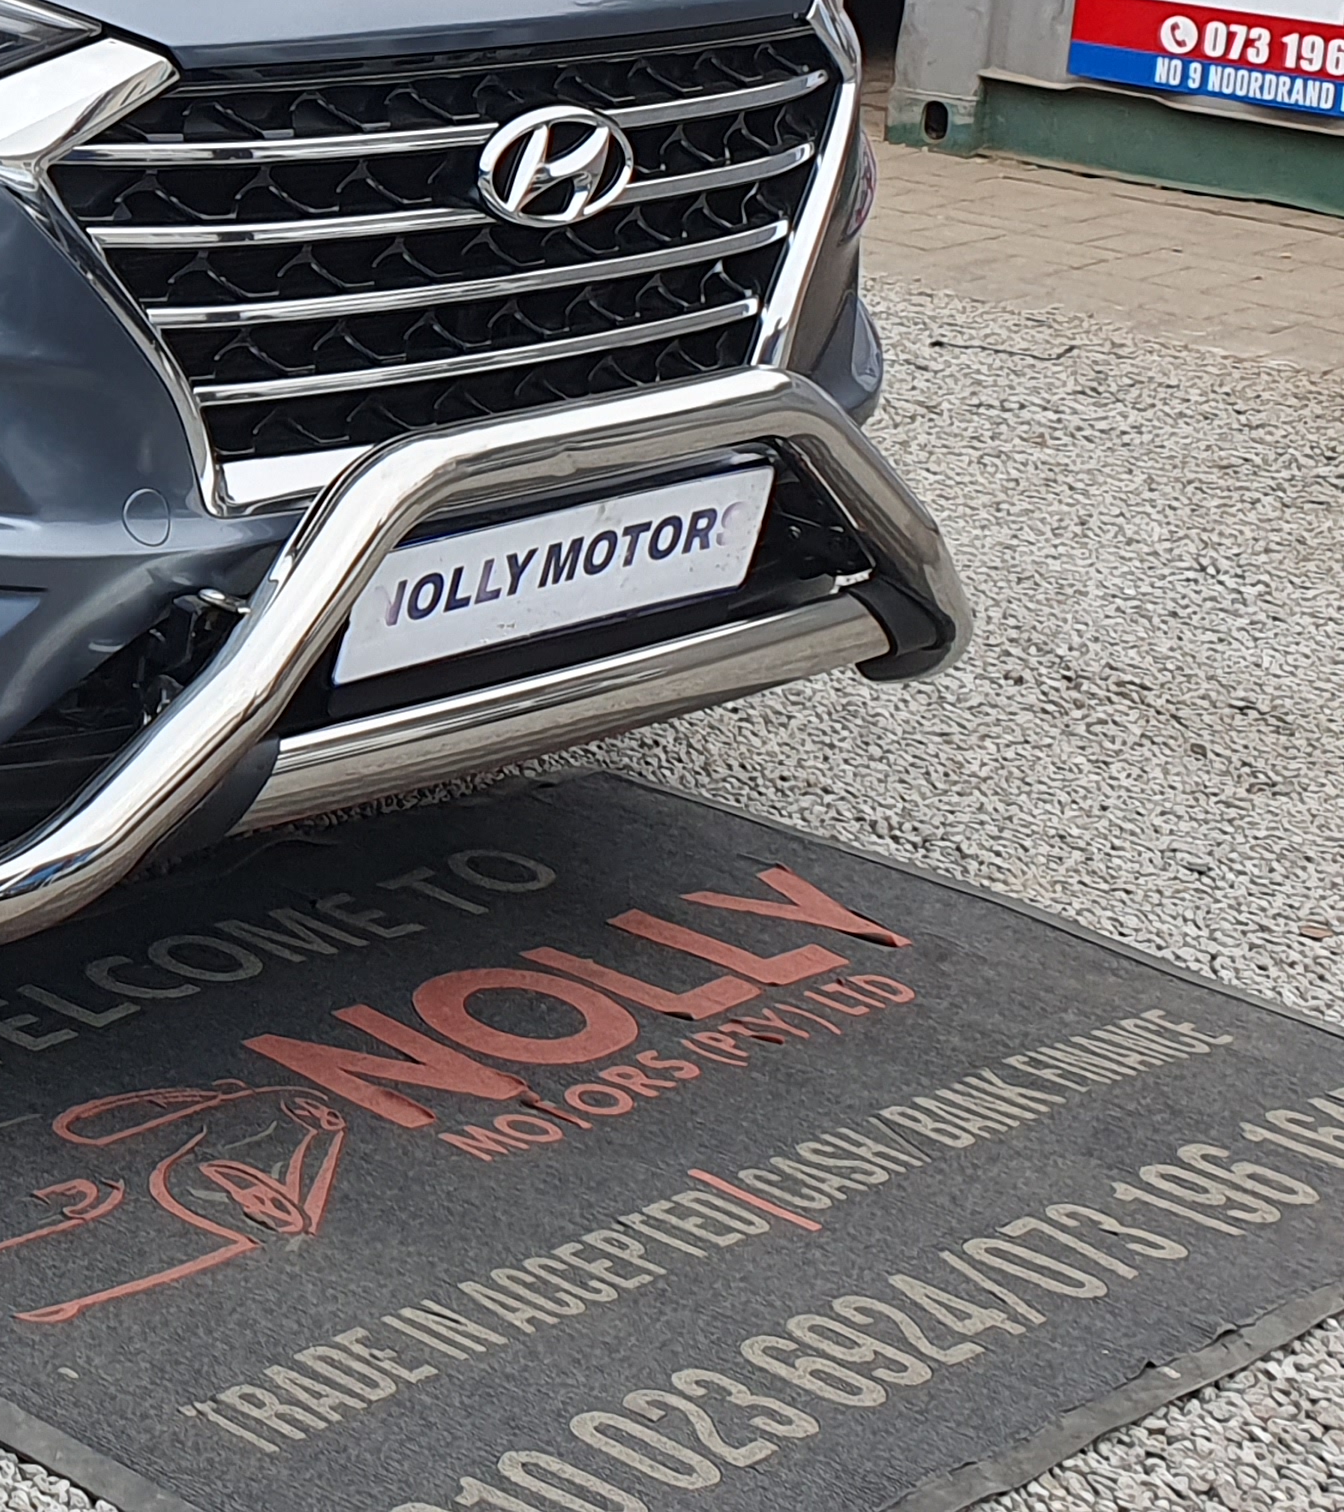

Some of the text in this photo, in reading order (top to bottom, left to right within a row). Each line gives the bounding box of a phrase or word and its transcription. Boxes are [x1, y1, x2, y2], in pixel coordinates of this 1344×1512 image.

[1154, 56, 1183, 86] NO
[1188, 61, 1203, 89] 9
[1207, 65, 1336, 110] NOORDRAND
[1203, 21, 1344, 76] 073 196
[376, 849, 557, 914] TO
[242, 863, 913, 1128] NOLLY
[438, 1050, 701, 1161] MOTORS
[802, 973, 916, 1016] LTD
[178, 1008, 1234, 1453] TRADE IN ACCEPTED CASH/BANK FINANCE
[569, 1369, 820, 1489] 023
[740, 1203, 1190, 1407] 6924/073
[1112, 1142, 1321, 1236] 196
